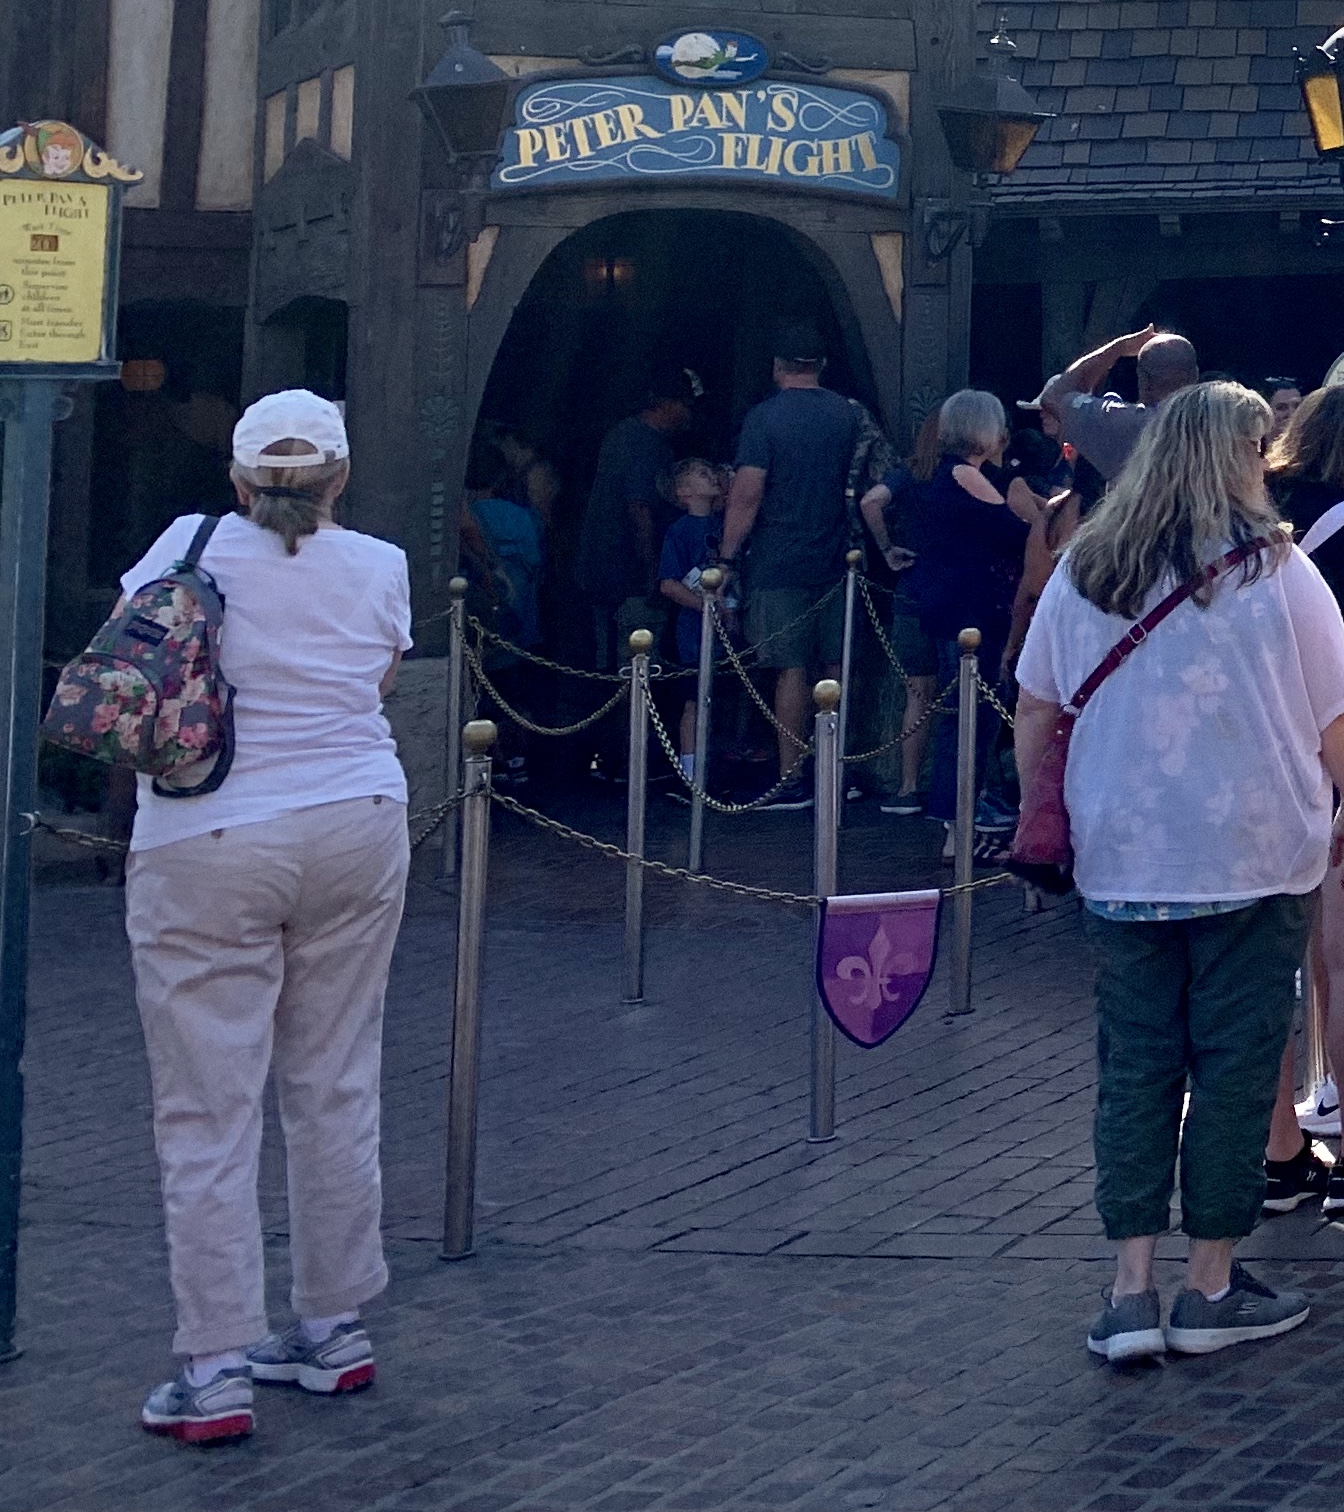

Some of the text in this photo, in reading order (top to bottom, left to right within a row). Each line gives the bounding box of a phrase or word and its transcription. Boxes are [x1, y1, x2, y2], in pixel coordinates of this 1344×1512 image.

[517, 90, 800, 168] PETER PAN'S
[718, 131, 882, 177] FLIGHT
